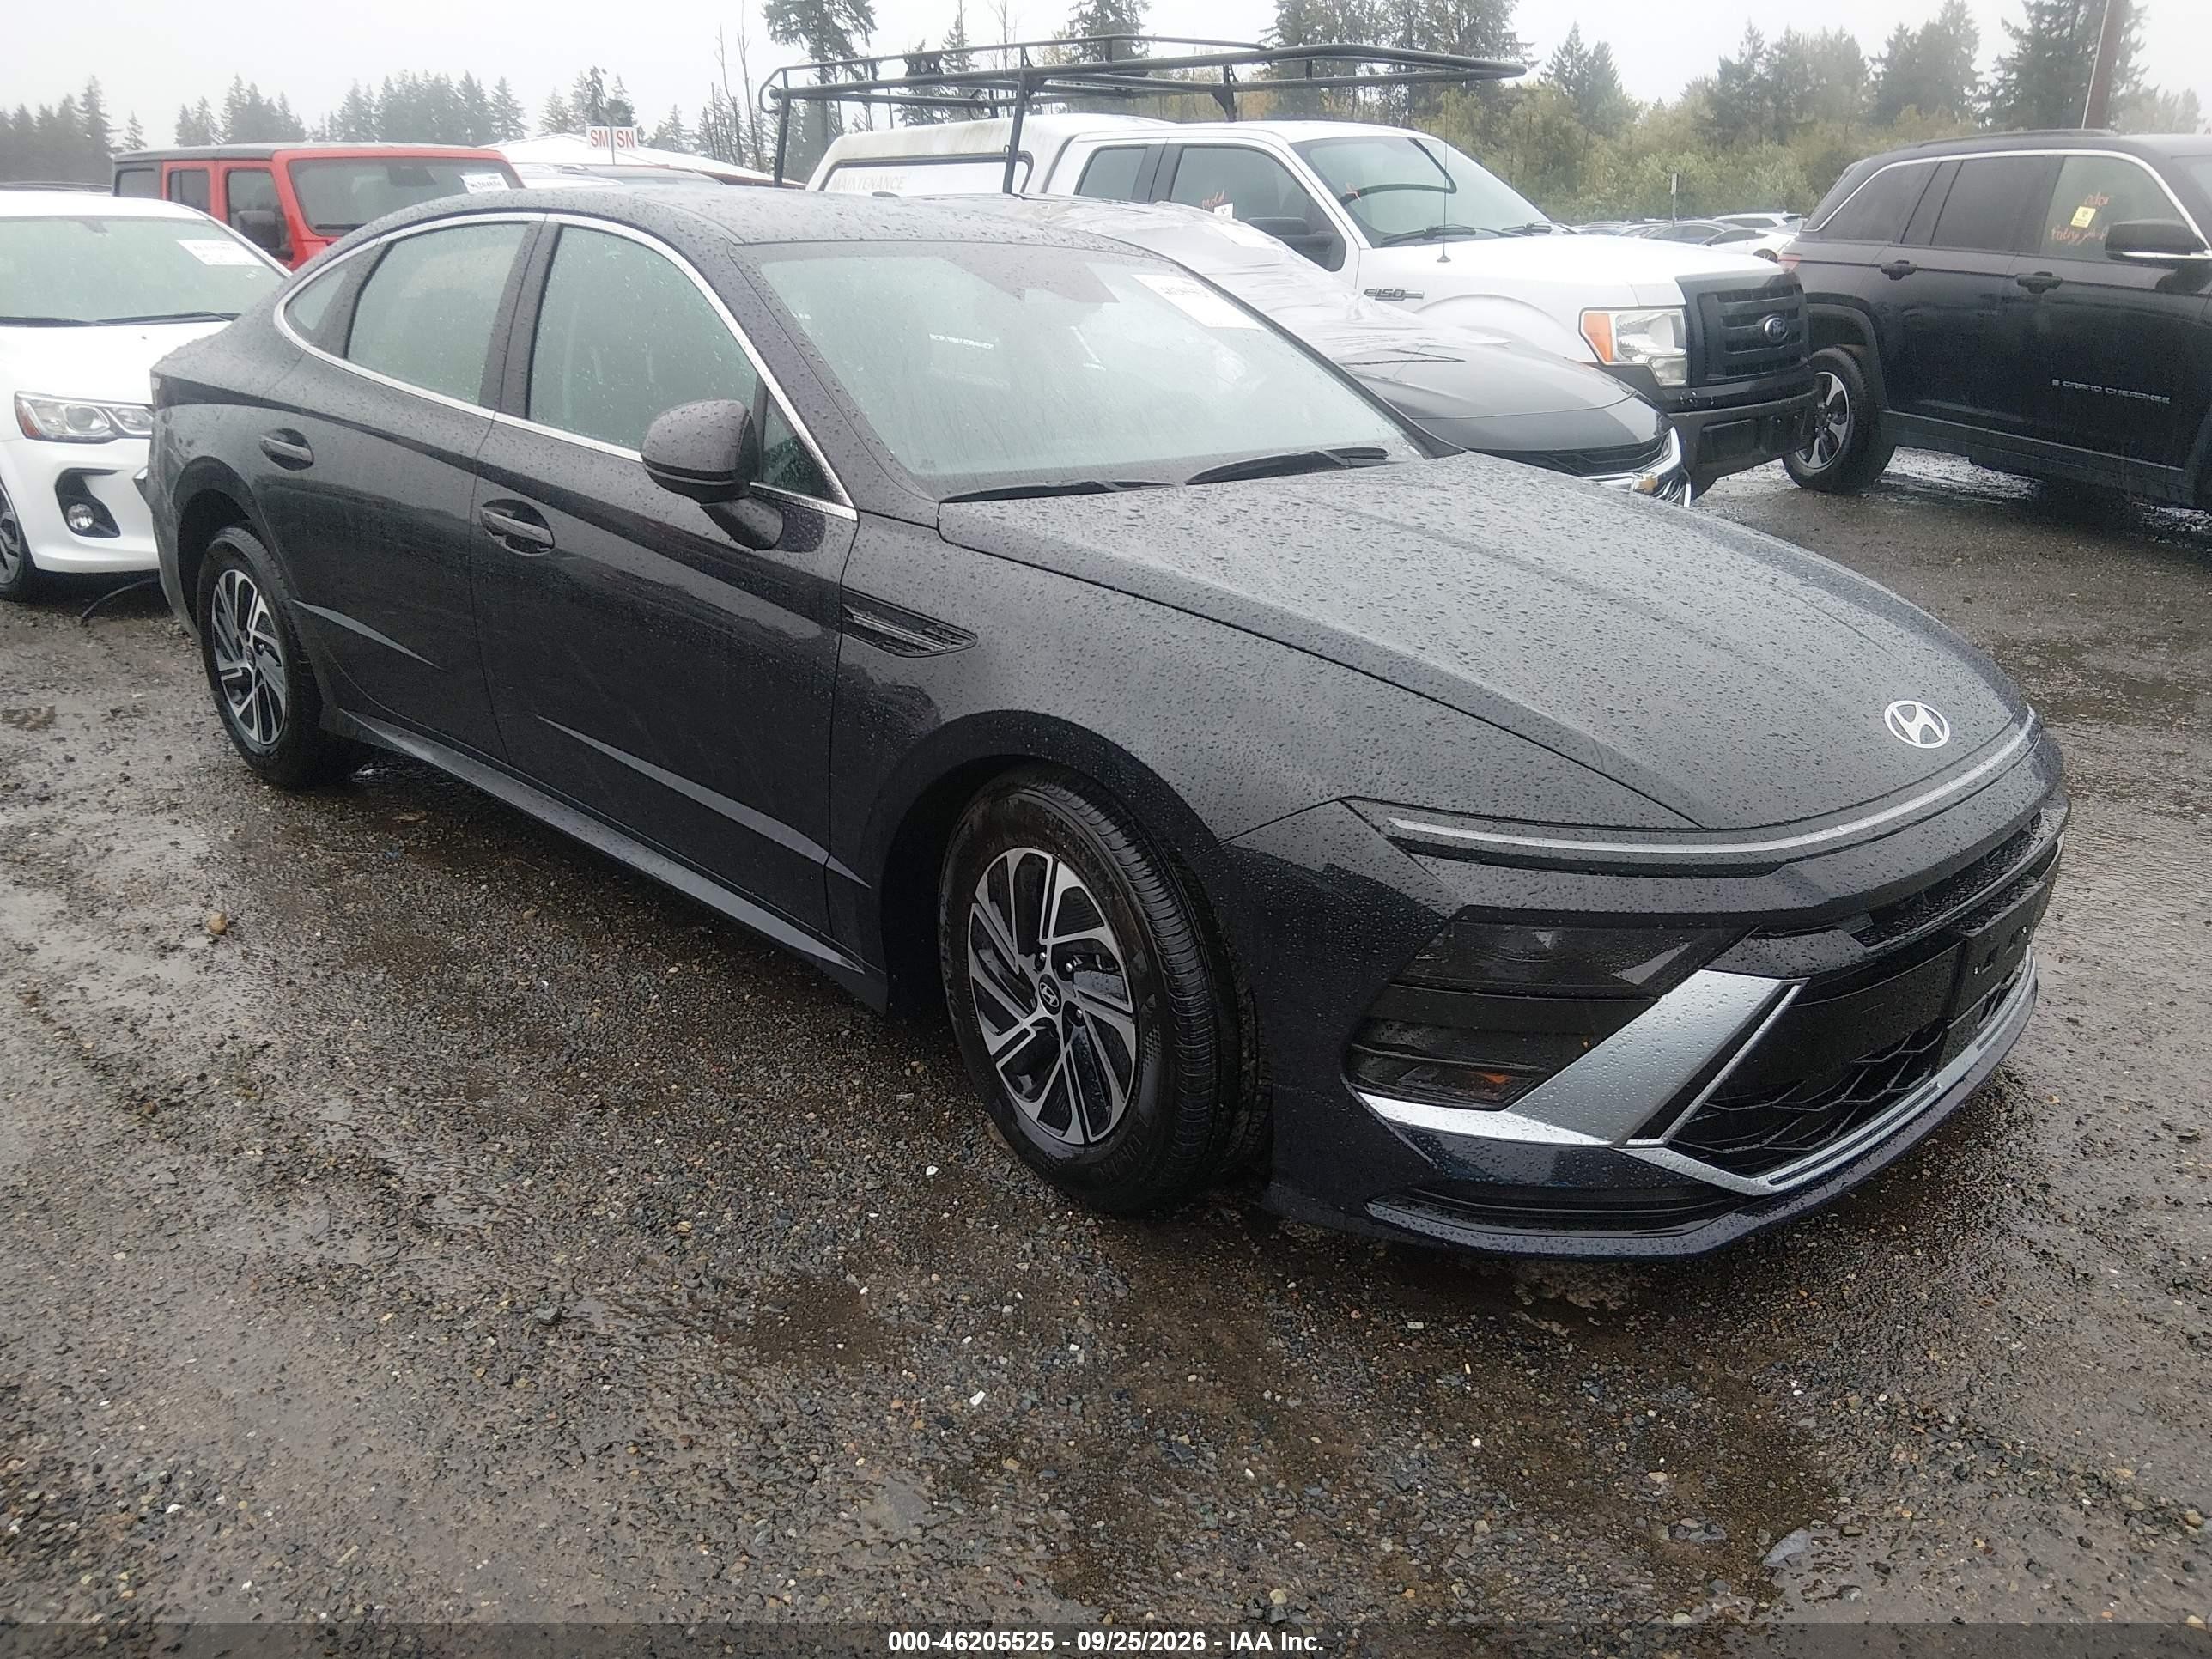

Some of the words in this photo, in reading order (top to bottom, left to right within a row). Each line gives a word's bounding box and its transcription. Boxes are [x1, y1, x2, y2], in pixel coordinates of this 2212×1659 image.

[590, 129, 609, 148] SM
[617, 130, 635, 149] SN
[830, 174, 907, 191] MAINTENANCE
[2062, 380, 2103, 392] GRAND
[2105, 386, 2171, 404] CHEROKEE
